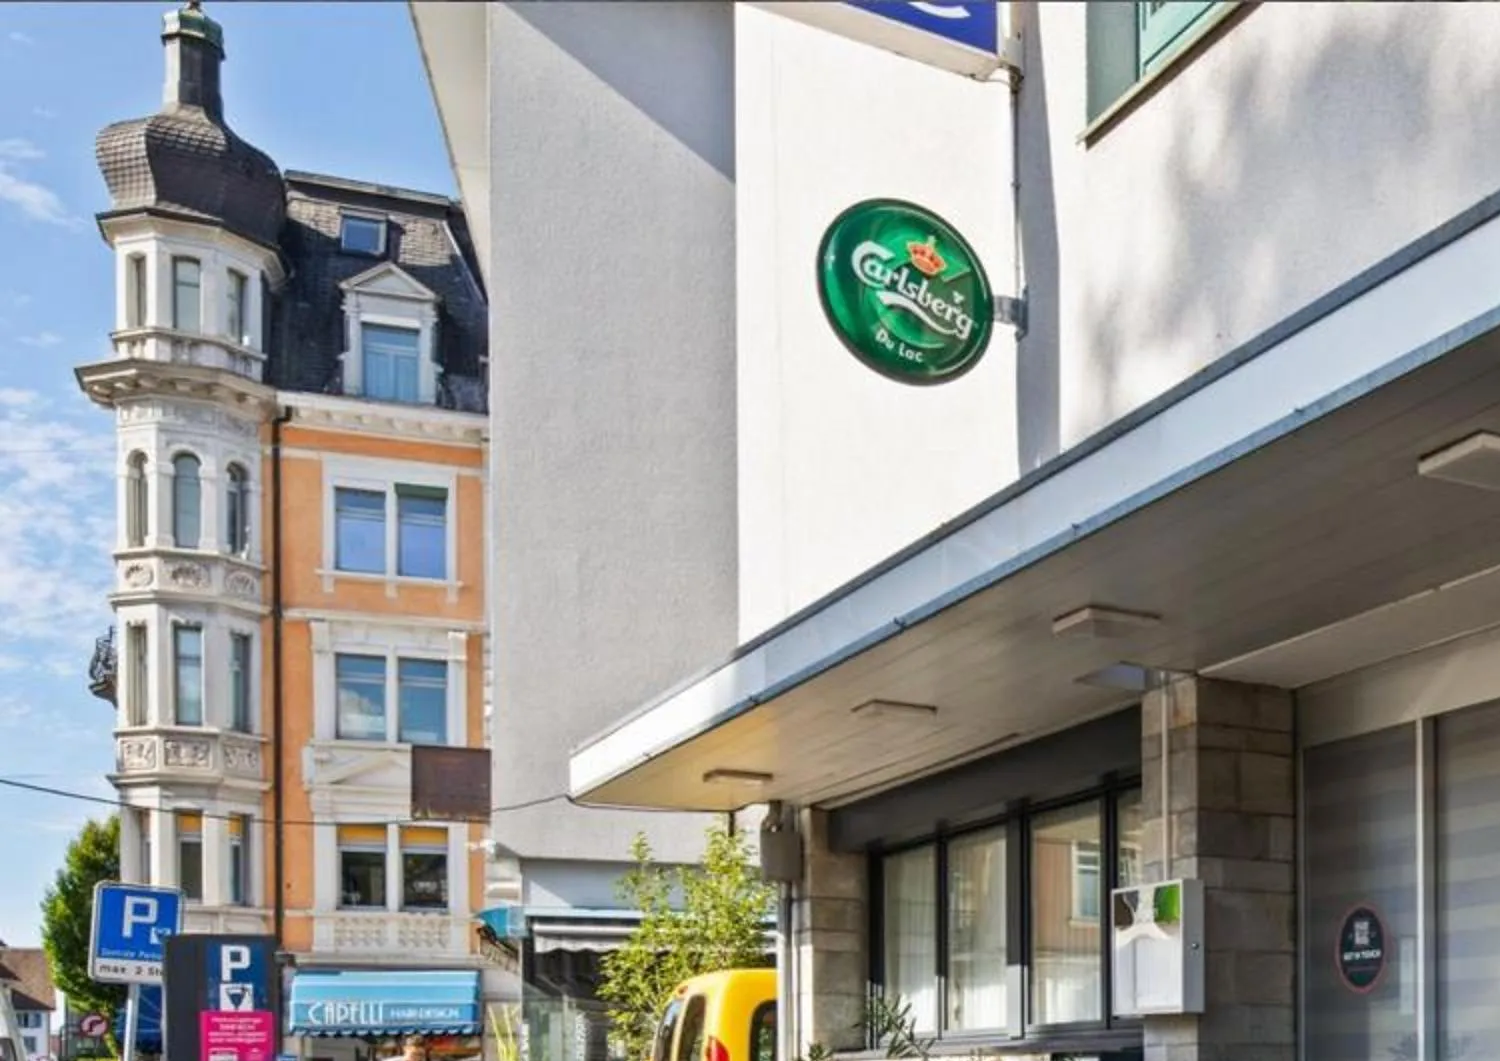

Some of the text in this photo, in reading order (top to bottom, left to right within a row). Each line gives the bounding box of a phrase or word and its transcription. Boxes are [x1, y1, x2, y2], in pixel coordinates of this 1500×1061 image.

[851, 240, 974, 340] Carlsberg
[875, 327, 925, 362] Du Lac
[122, 895, 158, 938] P
[220, 944, 250, 982] P
[308, 1000, 384, 1025] CAPELLI
